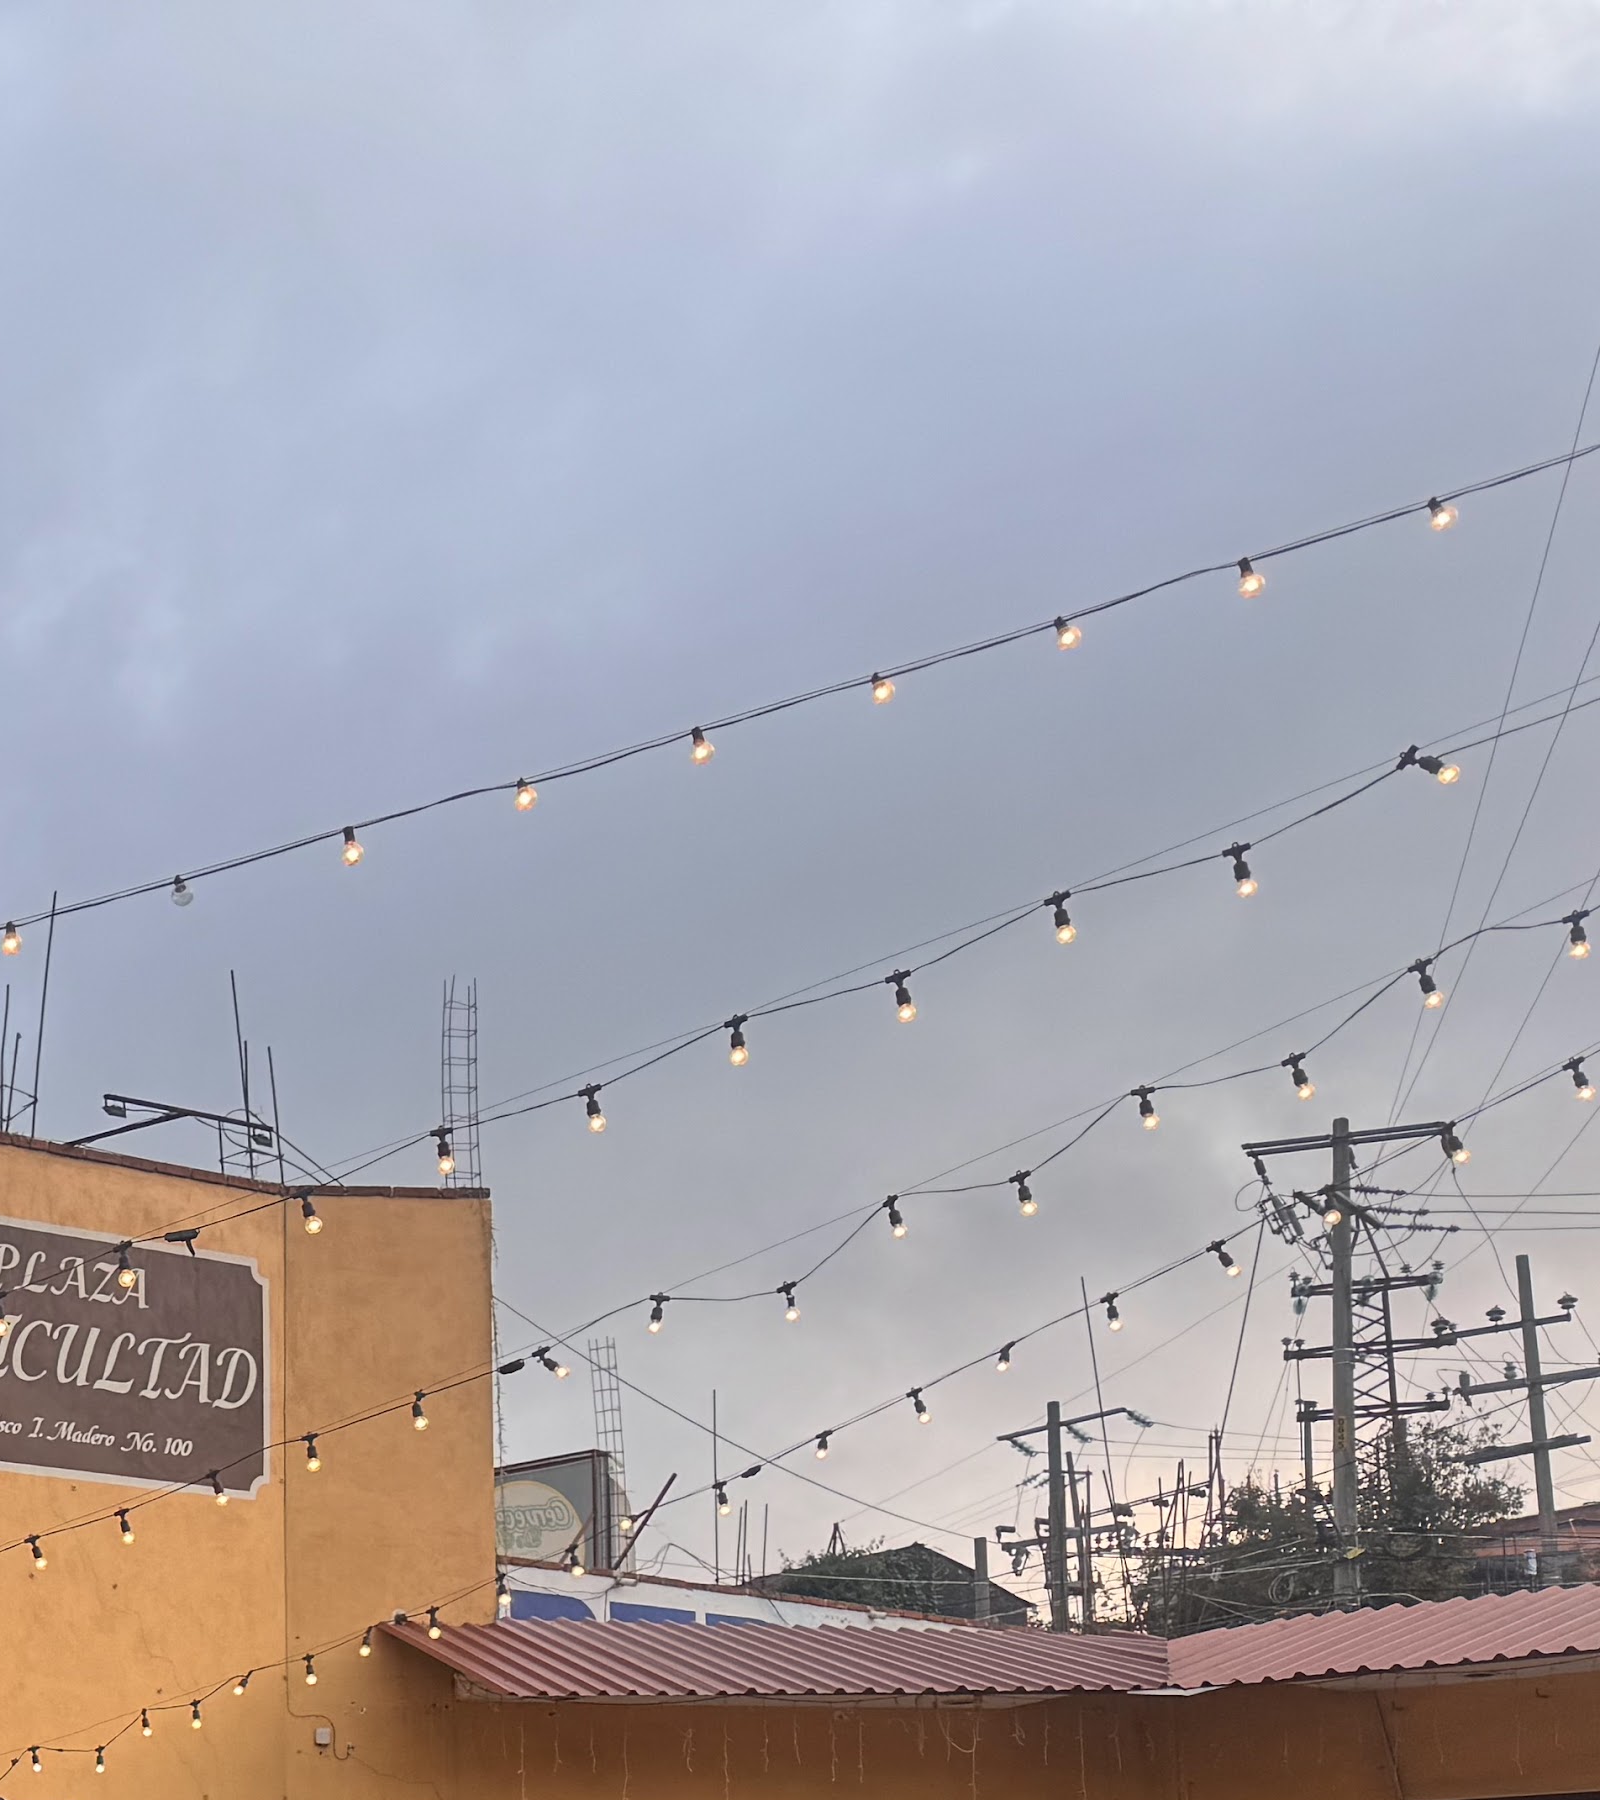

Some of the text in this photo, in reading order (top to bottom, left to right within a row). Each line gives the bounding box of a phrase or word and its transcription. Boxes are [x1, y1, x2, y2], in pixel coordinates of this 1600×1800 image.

[46, 1420, 115, 1448] Madero
[121, 1432, 158, 1456] No.
[164, 1438, 194, 1458] 100
